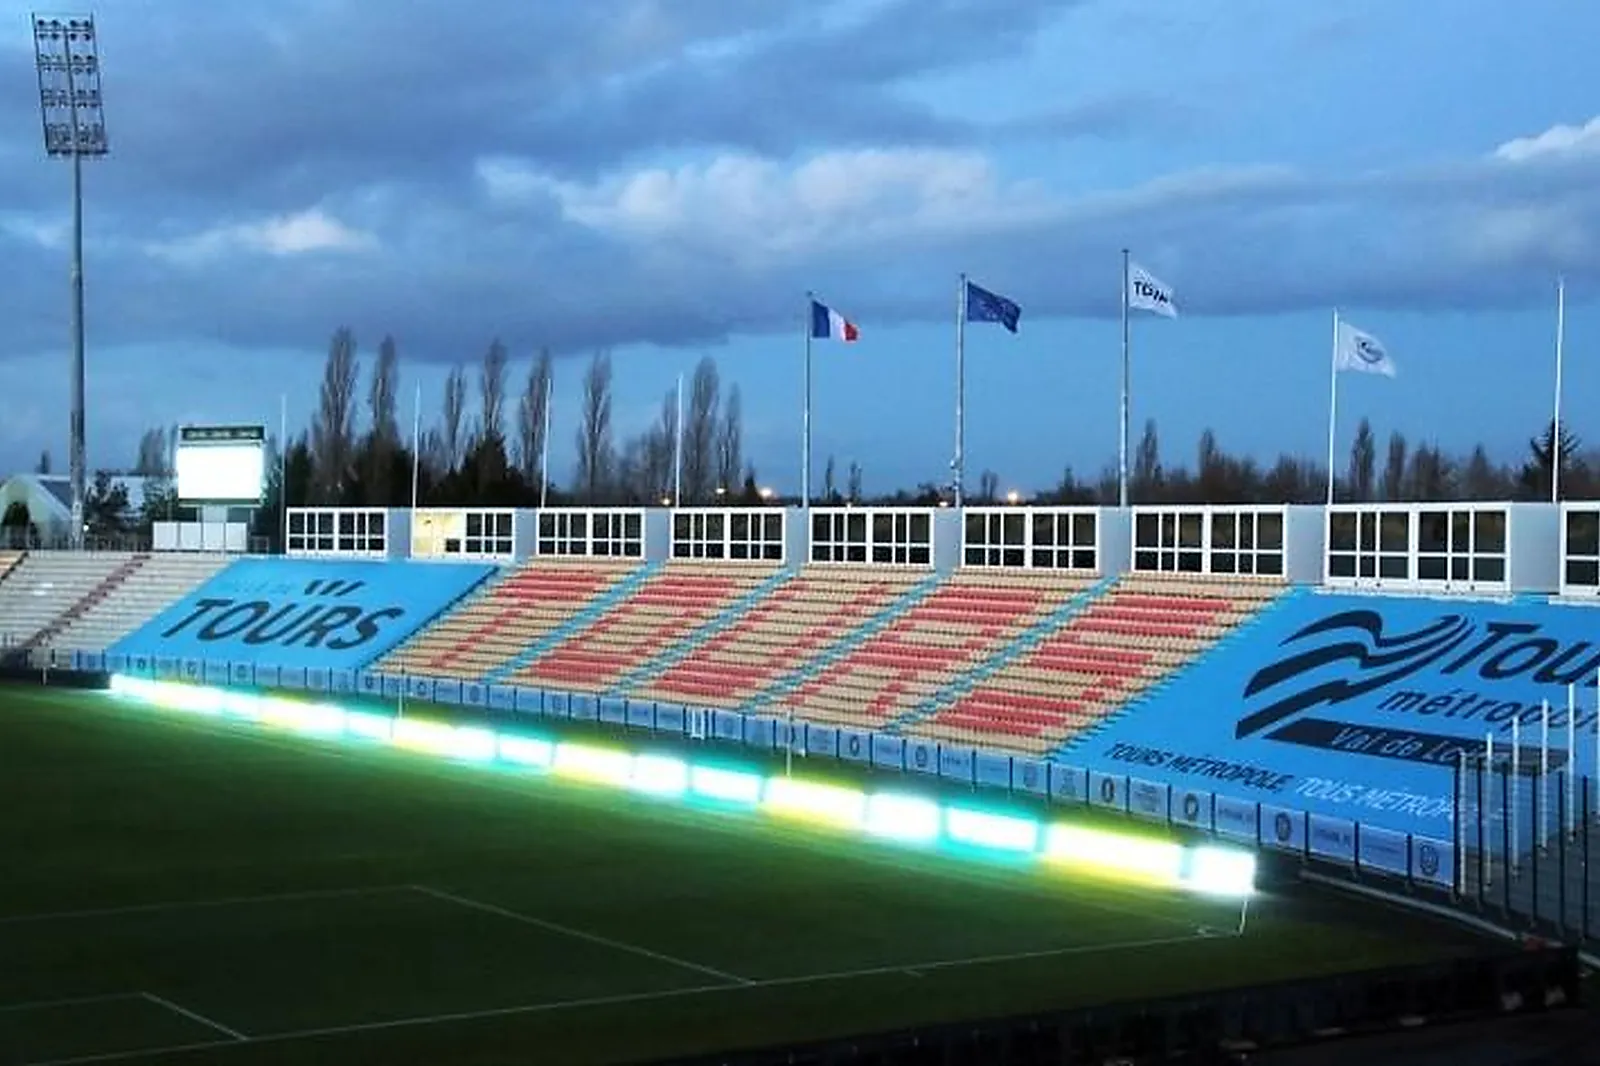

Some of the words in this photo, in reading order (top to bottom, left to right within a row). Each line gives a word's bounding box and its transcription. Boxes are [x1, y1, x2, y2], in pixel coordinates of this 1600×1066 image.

[161, 598, 405, 650] TOURS
[1440, 622, 1600, 687] Tou
[1104, 743, 1173, 767] TOURS
